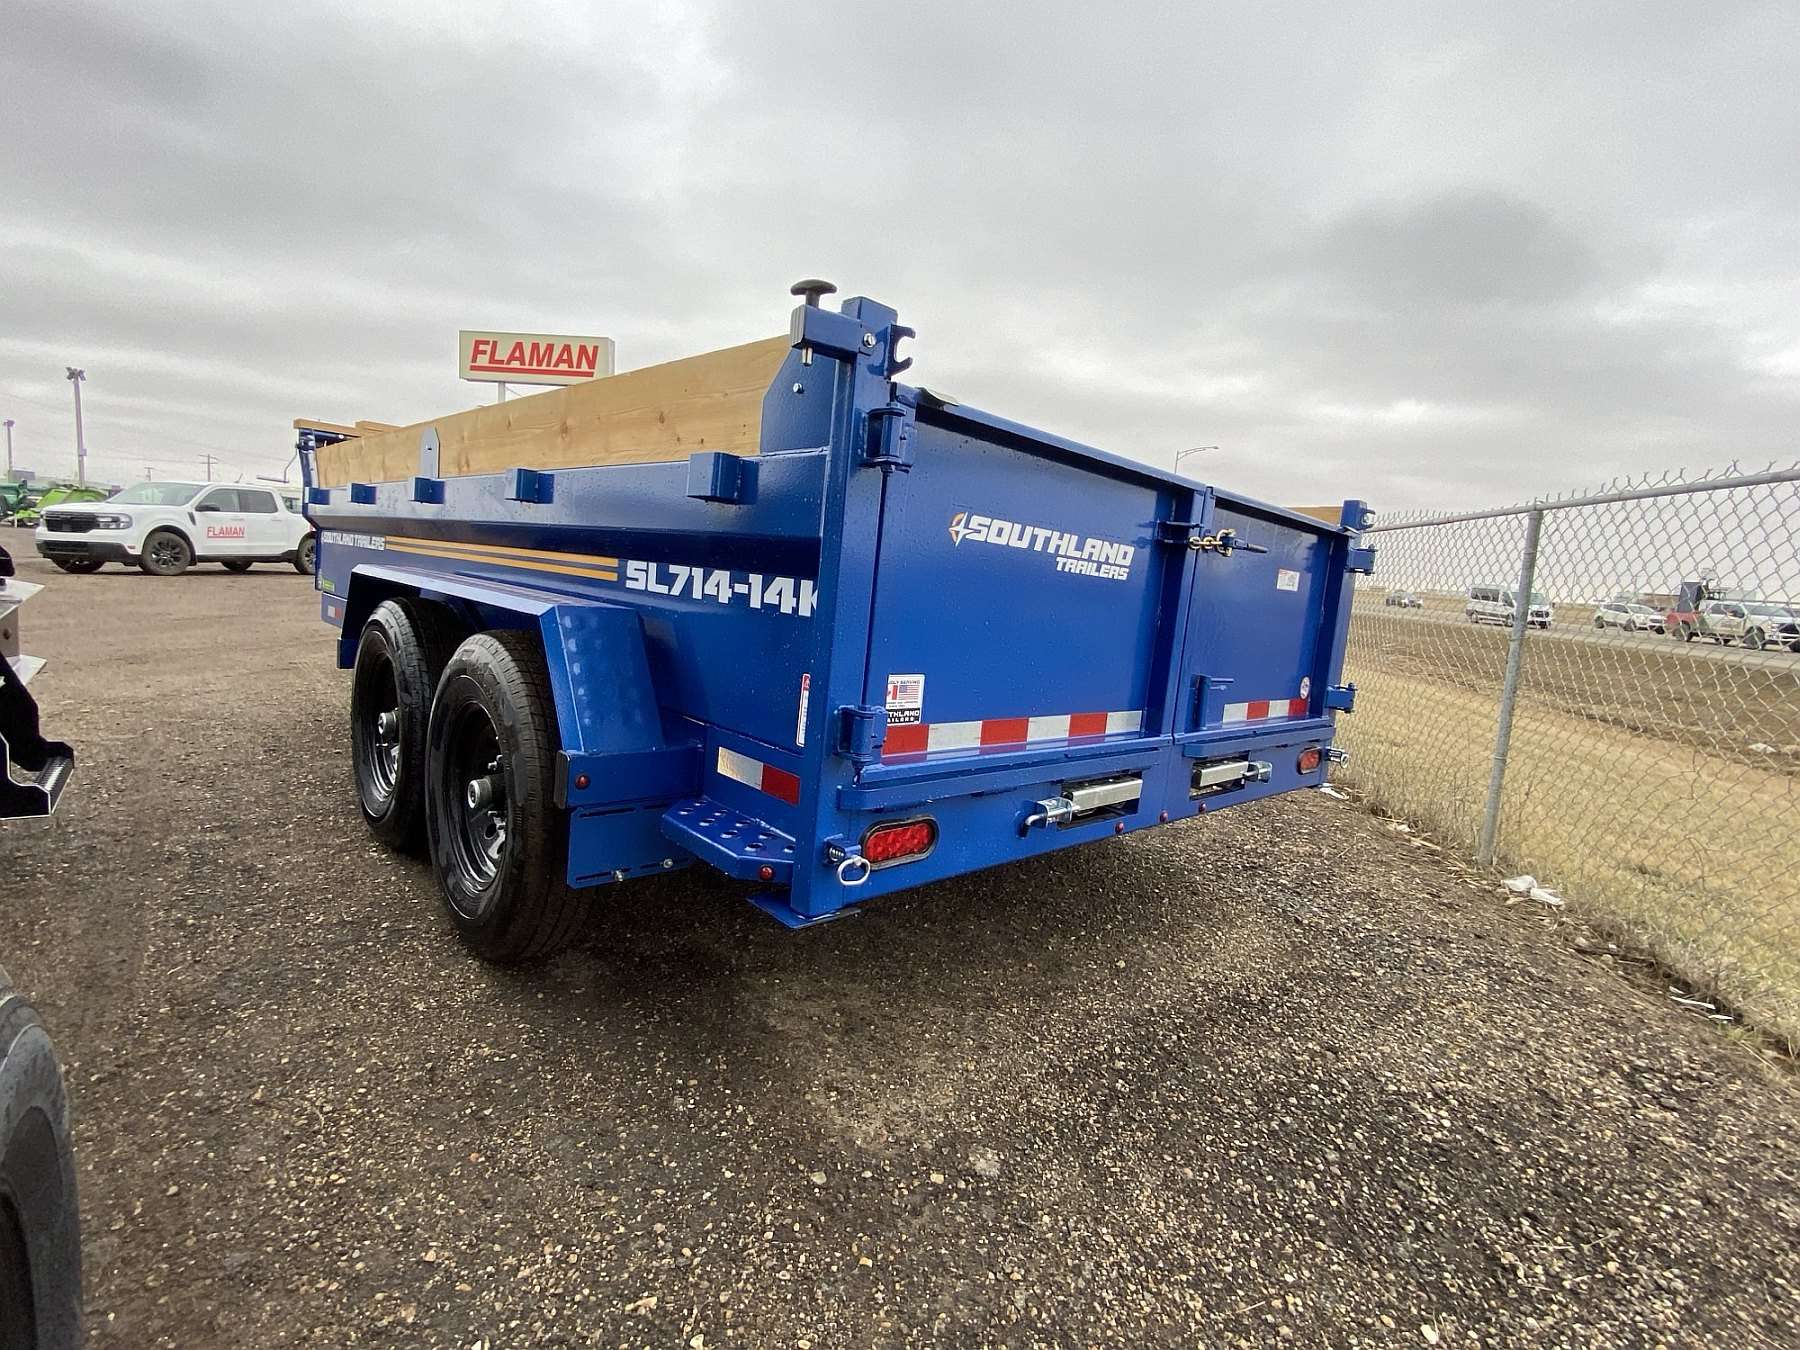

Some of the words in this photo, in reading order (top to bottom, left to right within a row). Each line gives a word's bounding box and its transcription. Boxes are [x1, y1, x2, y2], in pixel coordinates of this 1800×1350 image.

[471, 339, 599, 369] FLAMAN
[207, 526, 245, 536] FLAMAN
[323, 531, 354, 546] SOUTHLAND
[354, 534, 385, 550] TRAILERS
[966, 514, 1136, 566] SOUTHLAND
[1056, 556, 1130, 581] TRAILERS
